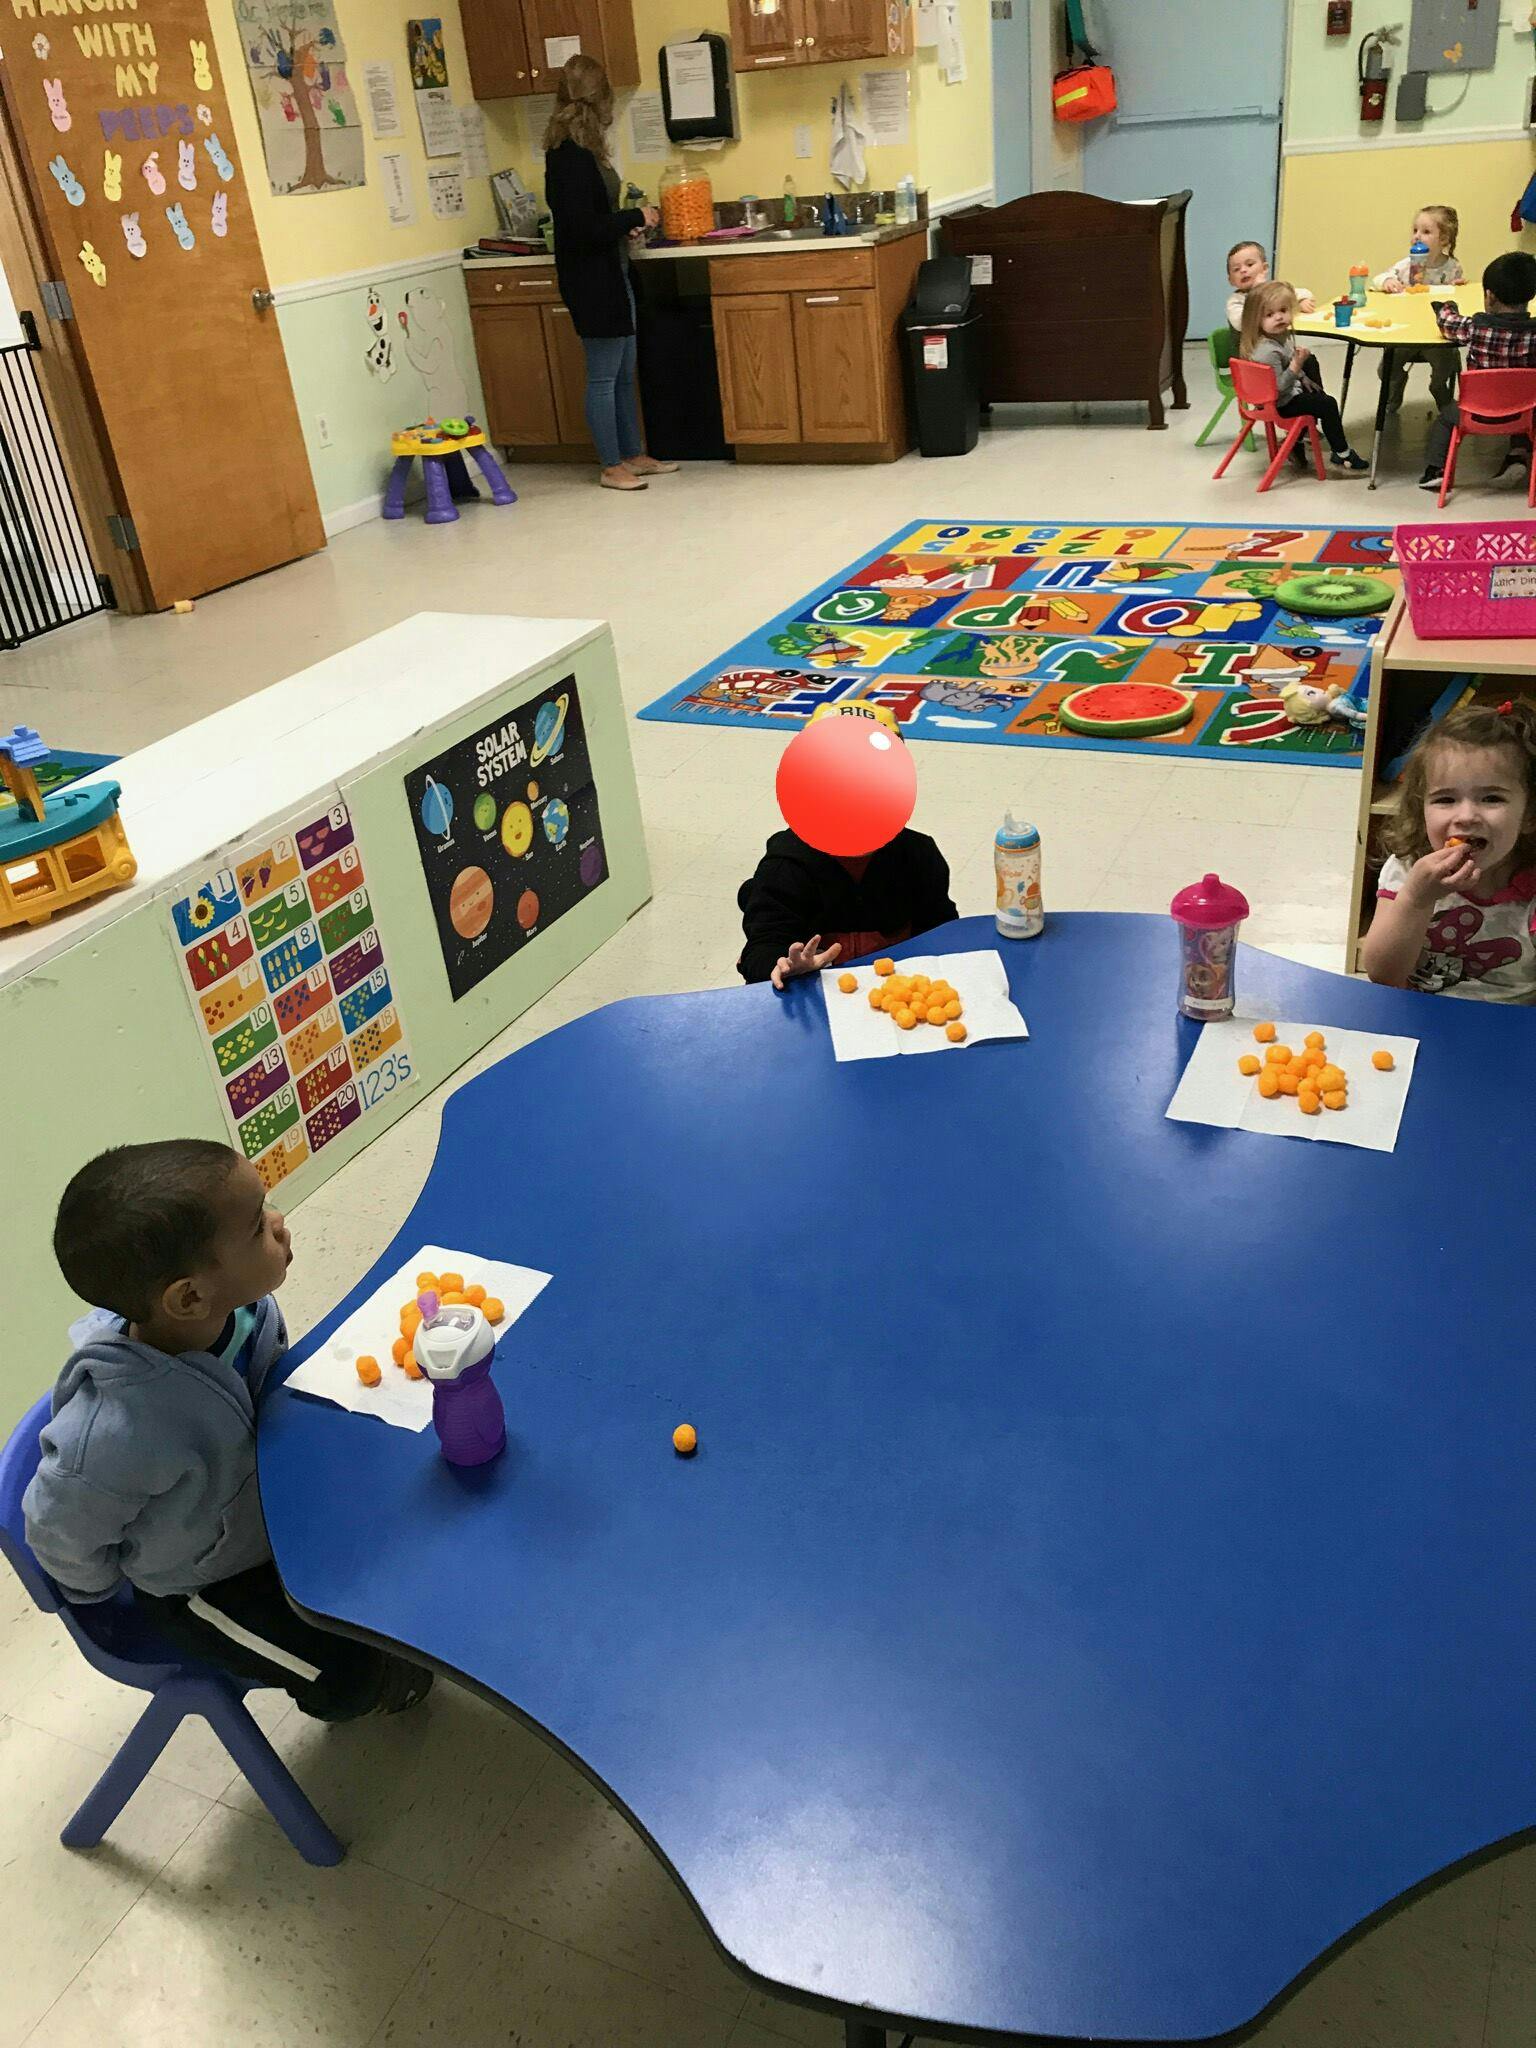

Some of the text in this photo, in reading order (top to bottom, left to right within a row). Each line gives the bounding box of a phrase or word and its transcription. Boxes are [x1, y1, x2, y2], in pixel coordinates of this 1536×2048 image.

[73, 22, 157, 59] WITH
[115, 61, 160, 98] MY
[981, 527, 1014, 540] 9
[1026, 528, 1062, 540] 8
[1071, 528, 1107, 540] 7
[1124, 528, 1157, 540] 6
[917, 540, 1135, 556] 1 2 3 4 5
[1235, 530, 1308, 559] Z
[1036, 560, 1115, 589] U
[812, 589, 892, 624] Q
[947, 593, 1037, 629] P
[1171, 643, 1258, 688] I
[766, 676, 870, 717] F
[475, 721, 521, 763] SOLAR
[476, 739, 528, 788] SYSTEM
[333, 807, 343, 826] 3
[277, 840, 289, 859] 2
[344, 850, 354, 868] 6
[217, 875, 226, 893] 1
[289, 884, 300, 903] 5
[353, 891, 363, 909] 9
[232, 921, 241, 940] 4
[300, 927, 311, 945] 8
[361, 933, 376, 952] 12
[244, 965, 255, 985] 7
[310, 970, 323, 990] 11
[369, 972, 384, 992] 15
[251, 1006, 268, 1029] 10
[318, 1010, 334, 1030] 14
[379, 1010, 393, 1030] 18
[264, 1048, 280, 1071] 13
[329, 1048, 345, 1069] 17
[358, 1053, 412, 1111] 123's
[276, 1089, 292, 1112] 16
[337, 1084, 355, 1106] 20
[284, 1128, 300, 1150] 19
